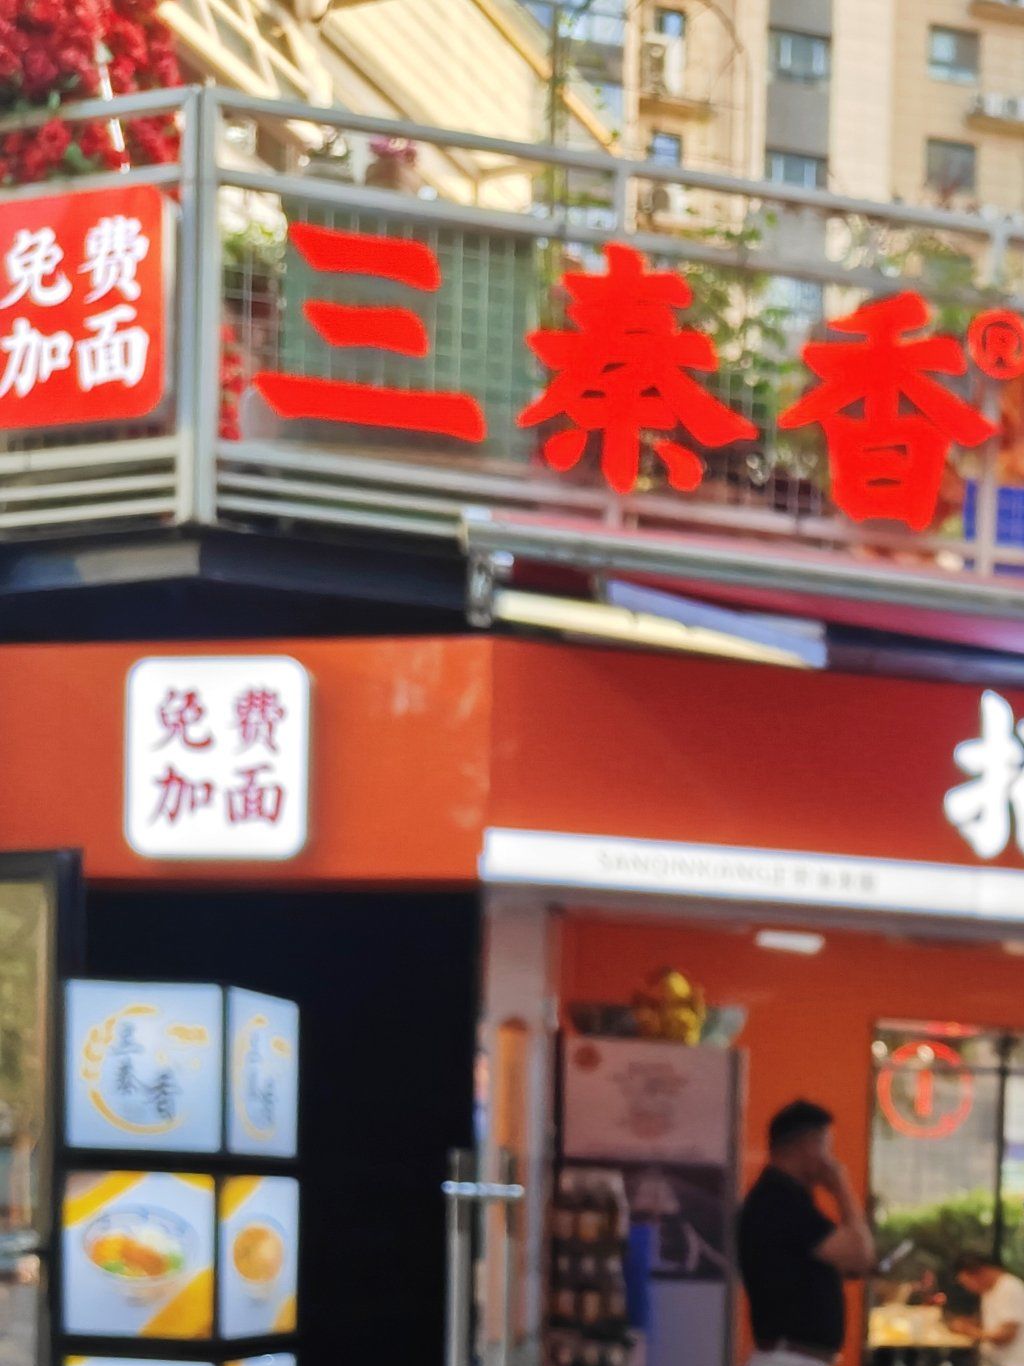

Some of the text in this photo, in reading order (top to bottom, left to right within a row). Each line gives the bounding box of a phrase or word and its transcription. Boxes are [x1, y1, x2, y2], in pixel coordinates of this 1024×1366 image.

[0, 214, 150, 309] 免费
[0, 304, 150, 398] 加面
[151, 686, 286, 753] 免费
[149, 762, 283, 827] 加面
